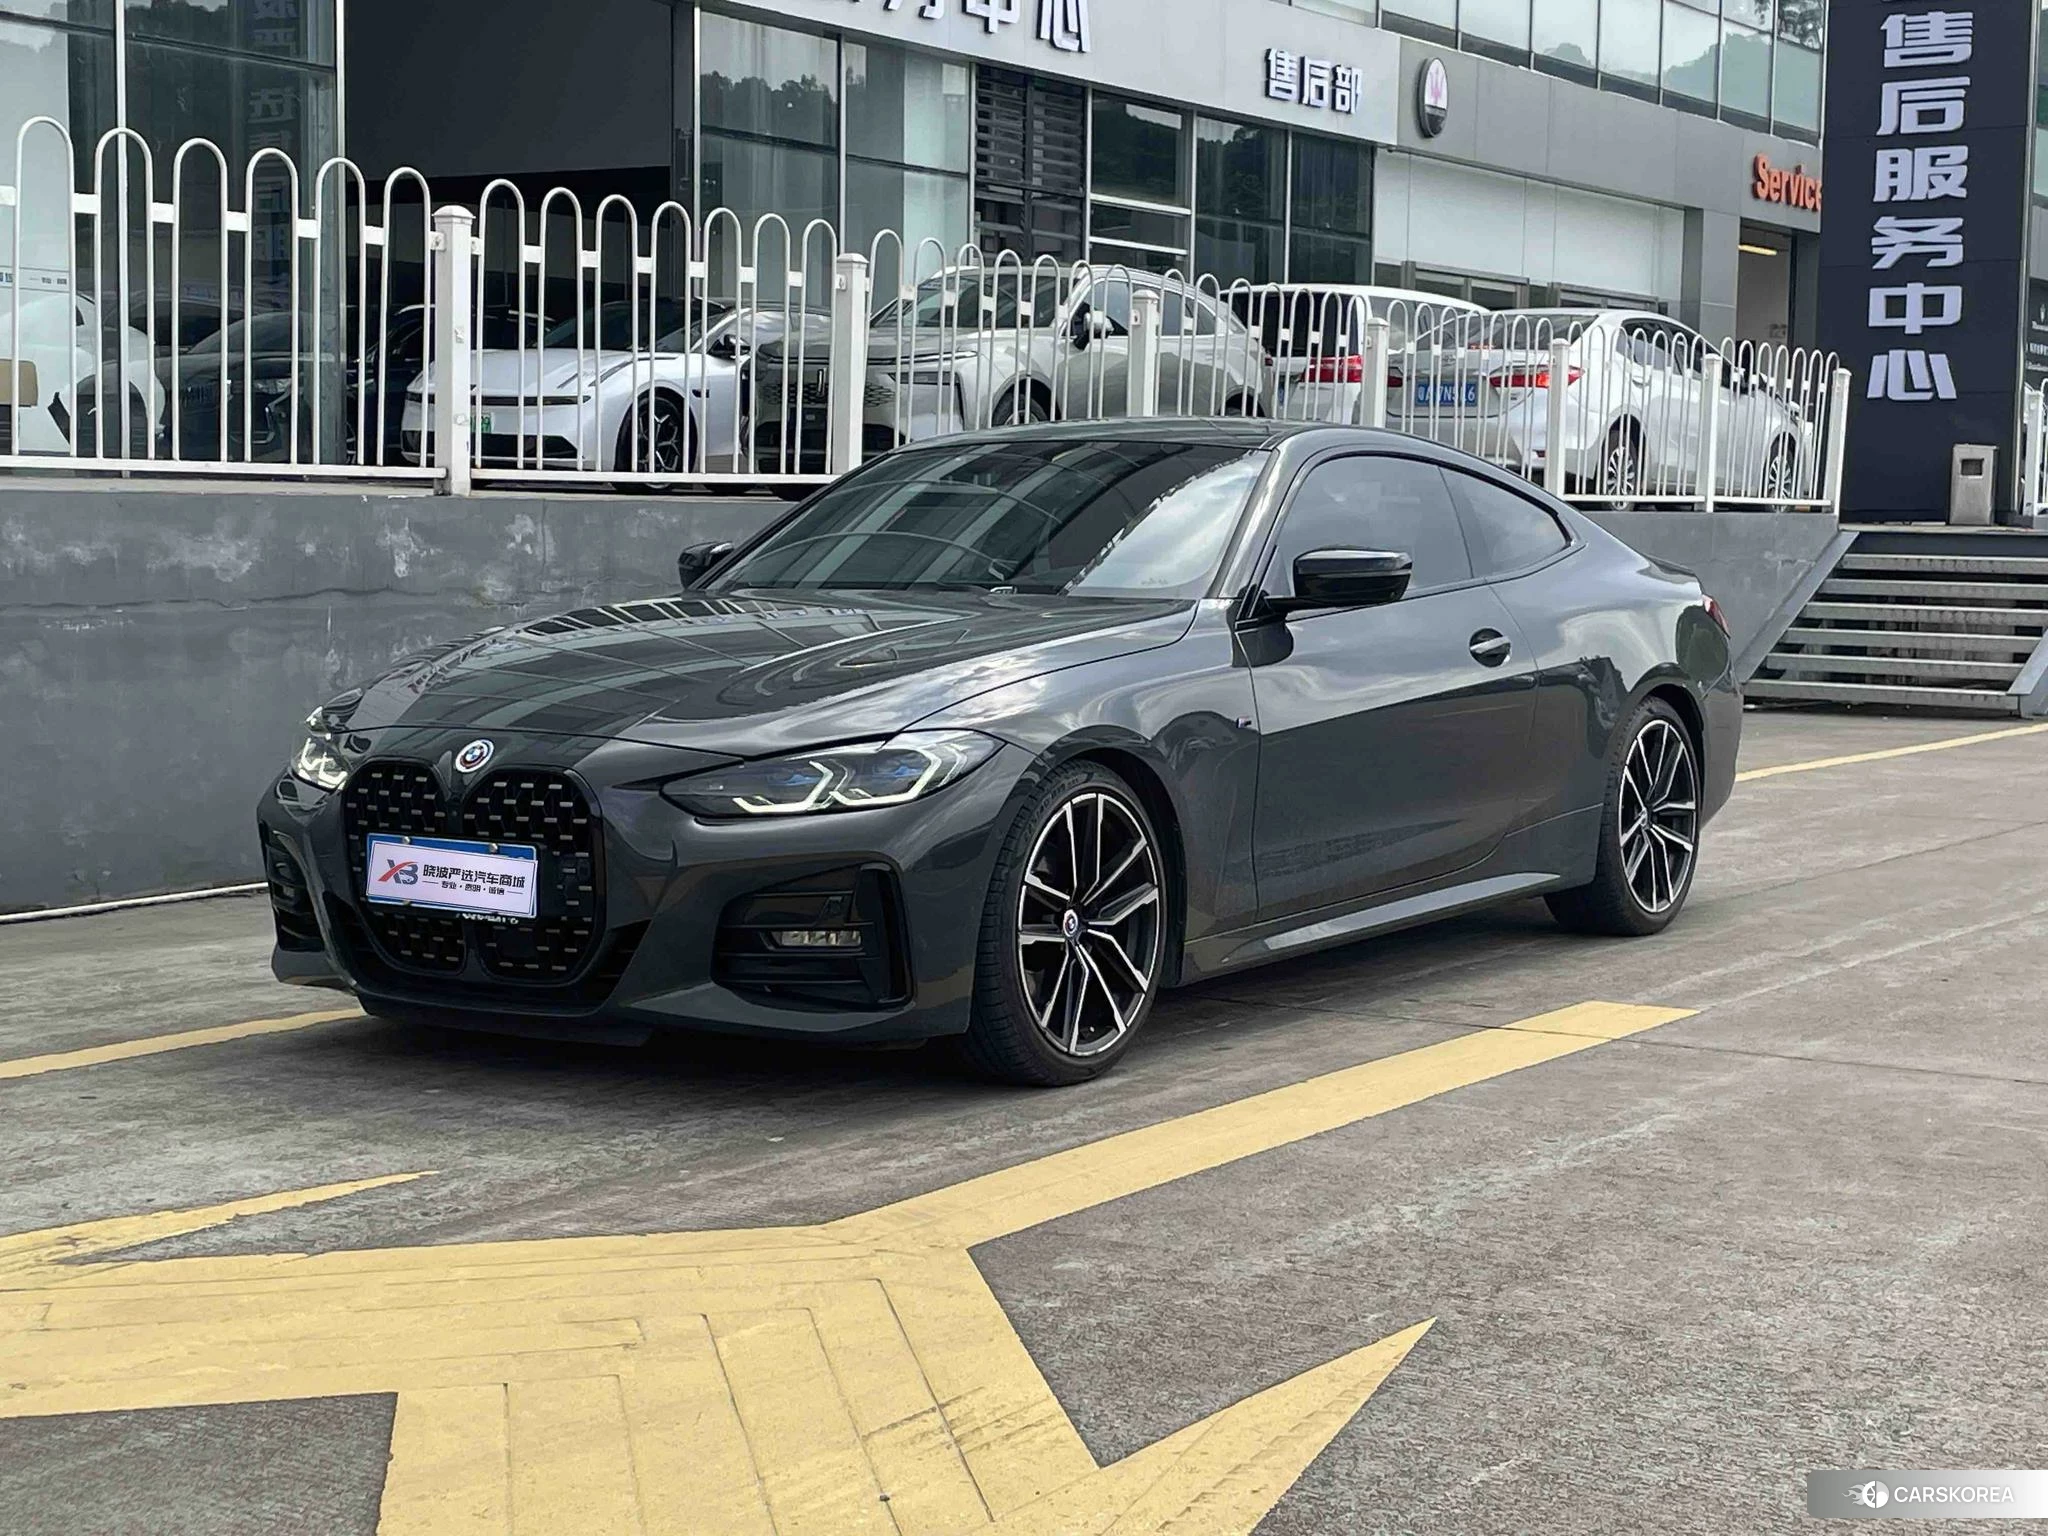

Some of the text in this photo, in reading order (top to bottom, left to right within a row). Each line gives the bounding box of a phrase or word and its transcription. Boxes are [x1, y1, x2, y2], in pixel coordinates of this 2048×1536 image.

[1266, 48, 1364, 114] 售后部
[1866, 12, 1973, 401] 售后服务中心
[423, 864, 525, 888] 晓波严选汽车商城
